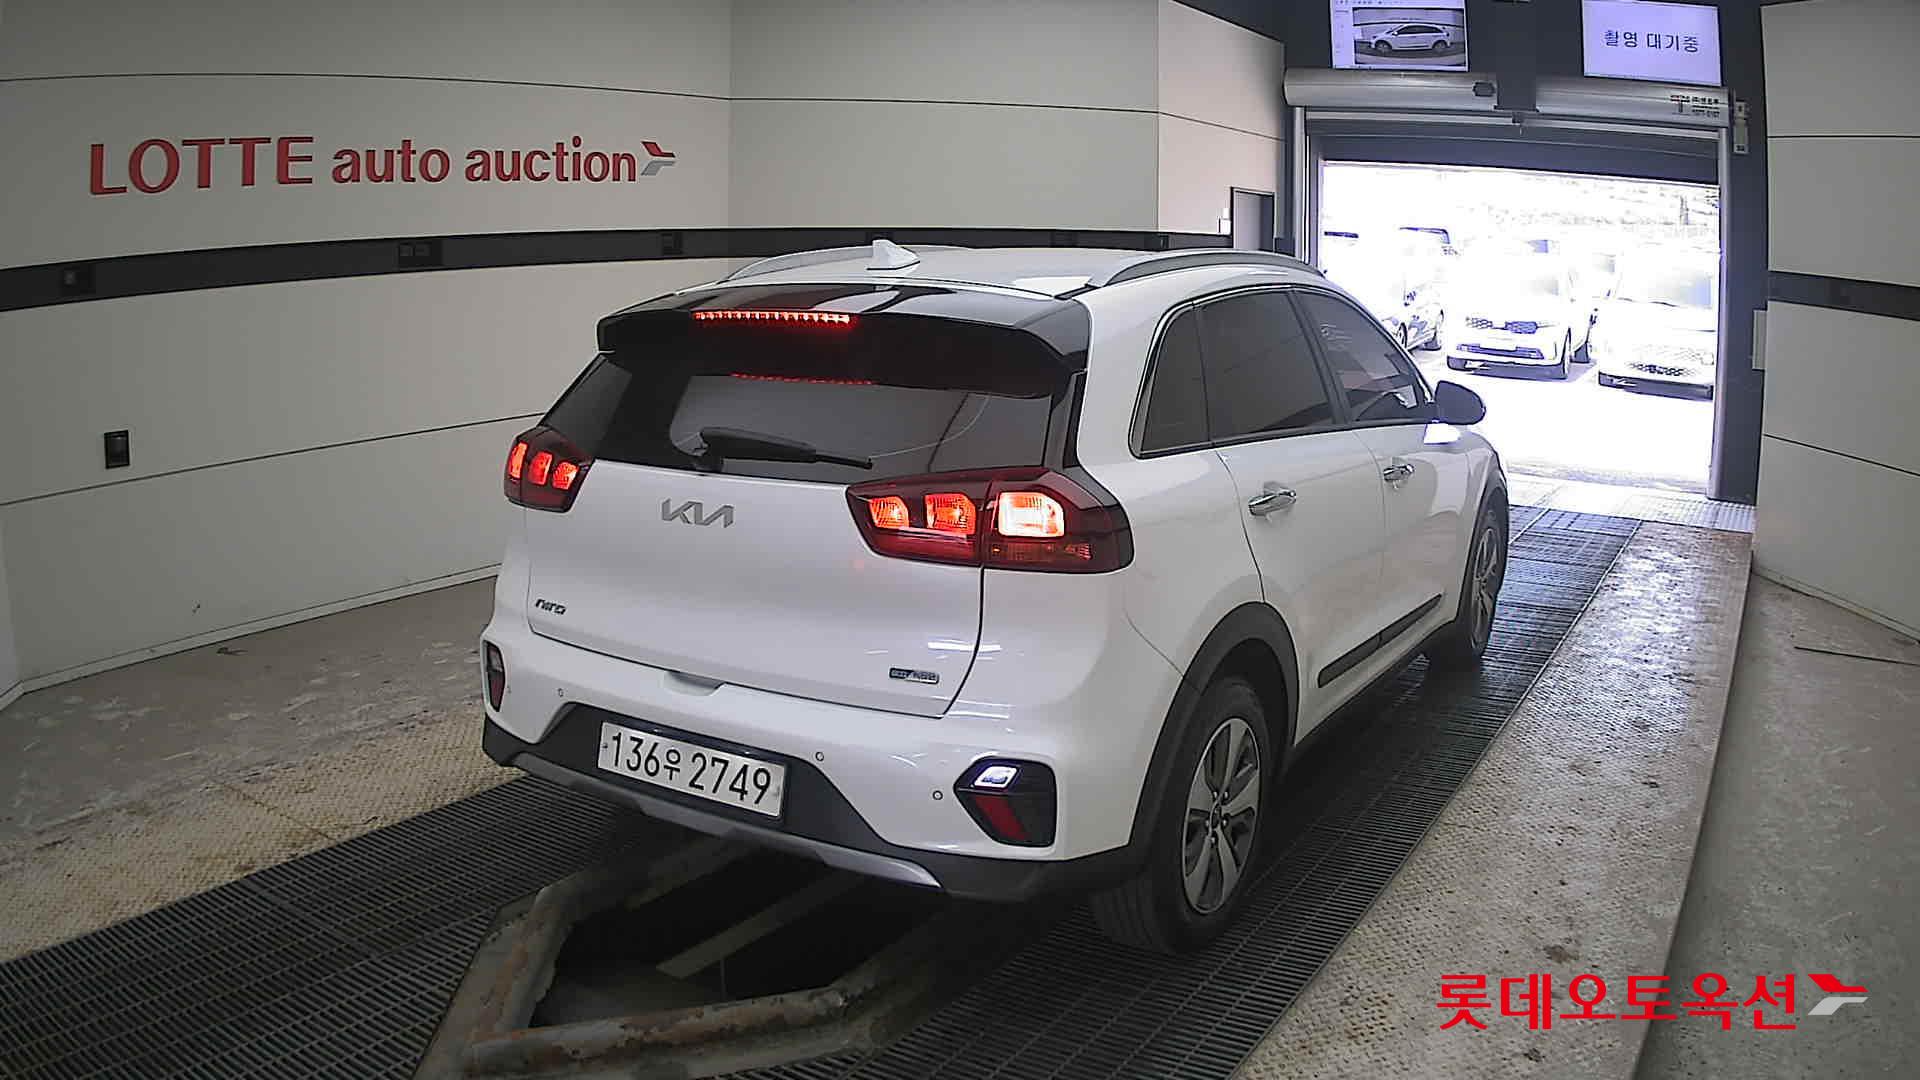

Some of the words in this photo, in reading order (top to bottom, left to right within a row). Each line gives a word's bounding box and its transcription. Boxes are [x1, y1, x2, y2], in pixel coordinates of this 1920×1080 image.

[1605, 30, 1637, 48] 촬영
[1646, 33, 1698, 52] 대기중
[89, 135, 315, 196] LOTTE
[331, 138, 451, 184] auto
[463, 135, 638, 183] auction
[661, 498, 735, 529] KIA
[612, 731, 681, 781] 136우
[688, 752, 772, 805] 2749
